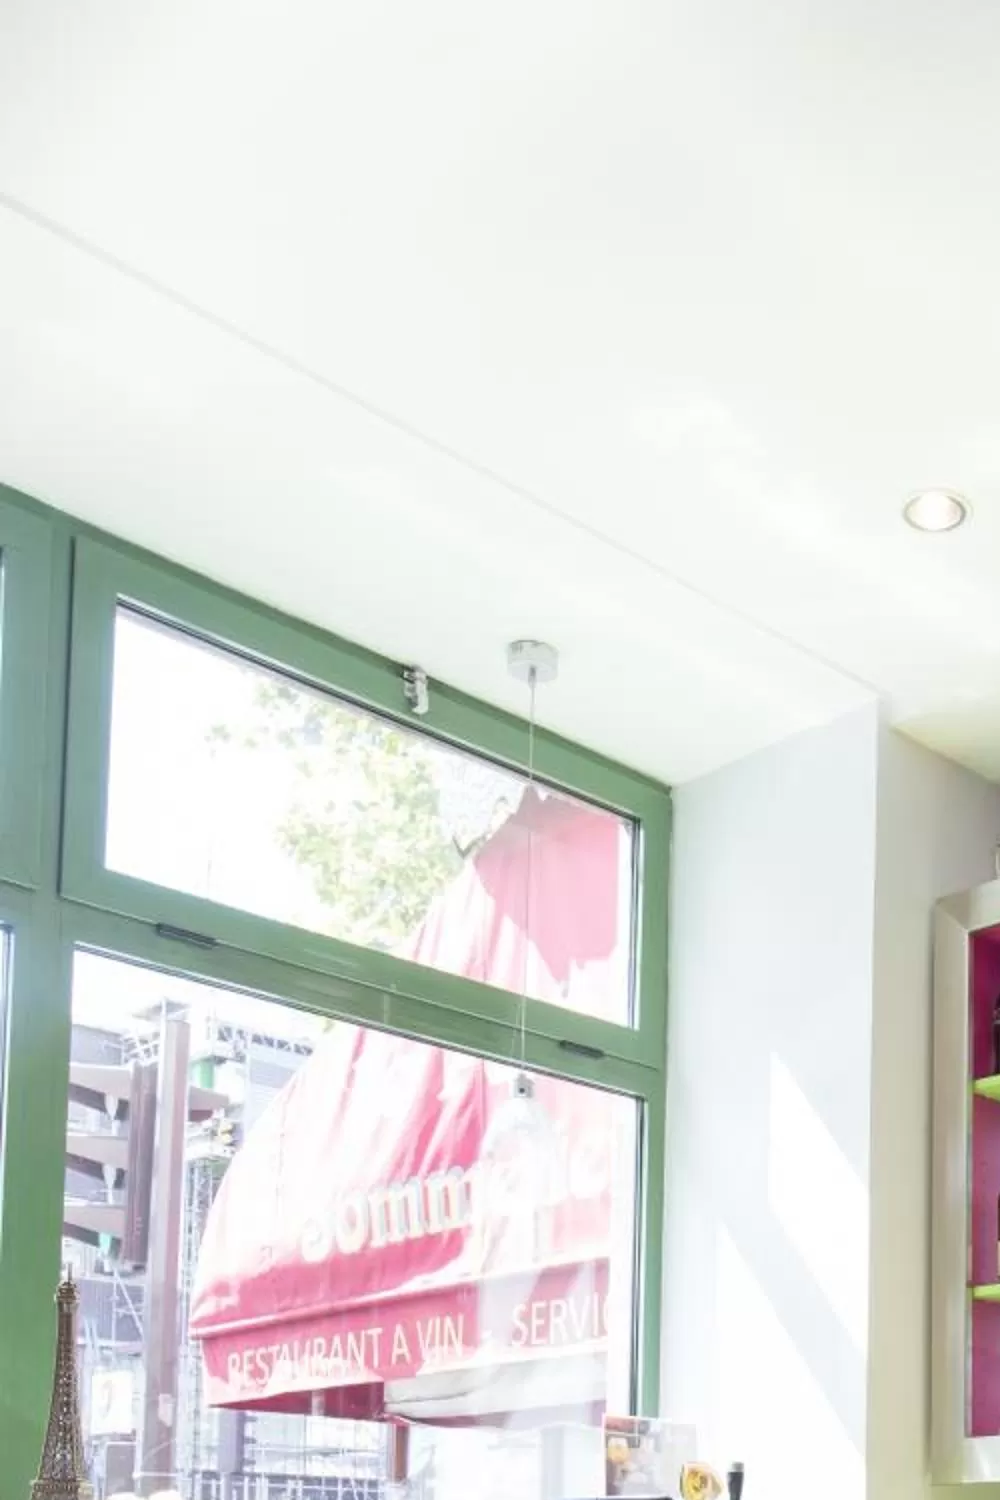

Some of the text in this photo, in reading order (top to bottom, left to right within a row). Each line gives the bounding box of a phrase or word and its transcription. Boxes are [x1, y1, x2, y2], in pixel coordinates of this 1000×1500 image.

[226, 1326, 383, 1389] RESTAURANT
[391, 1323, 411, 1366] A
[415, 1312, 466, 1361] VIN
